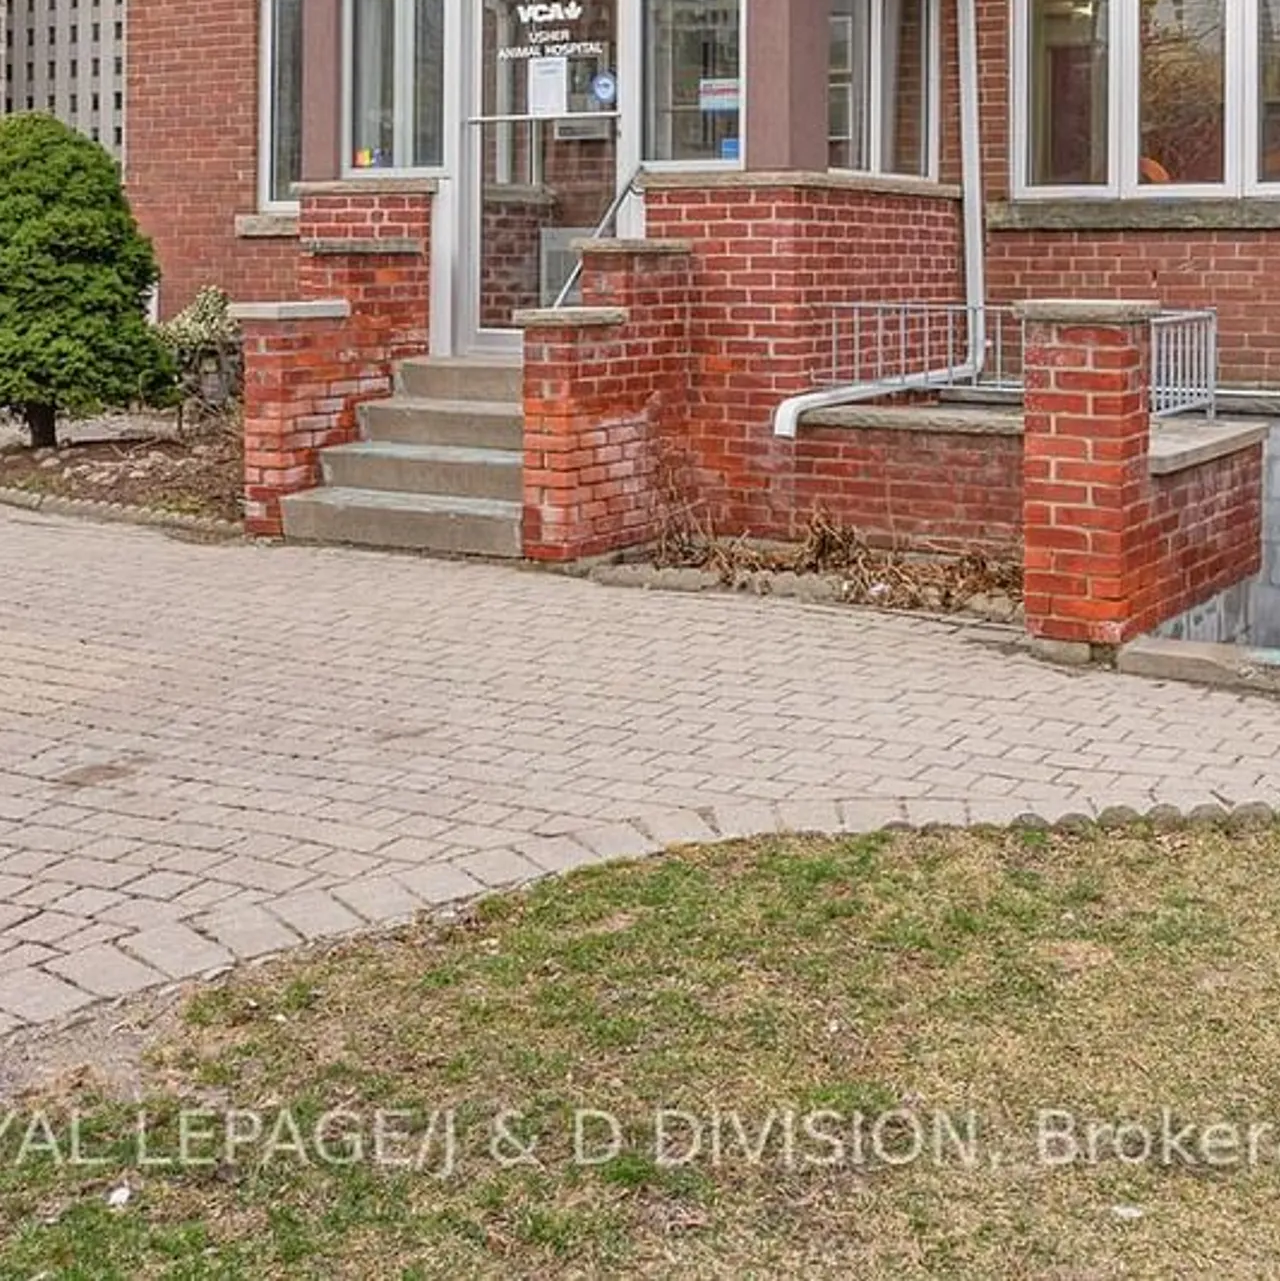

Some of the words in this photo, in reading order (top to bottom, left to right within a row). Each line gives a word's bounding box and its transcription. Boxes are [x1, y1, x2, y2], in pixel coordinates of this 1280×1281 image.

[517, 3, 565, 23] VCA
[528, 29, 570, 44] USHER
[498, 46, 542, 60] ANIMAL
[544, 41, 603, 57] HOSPITAL
